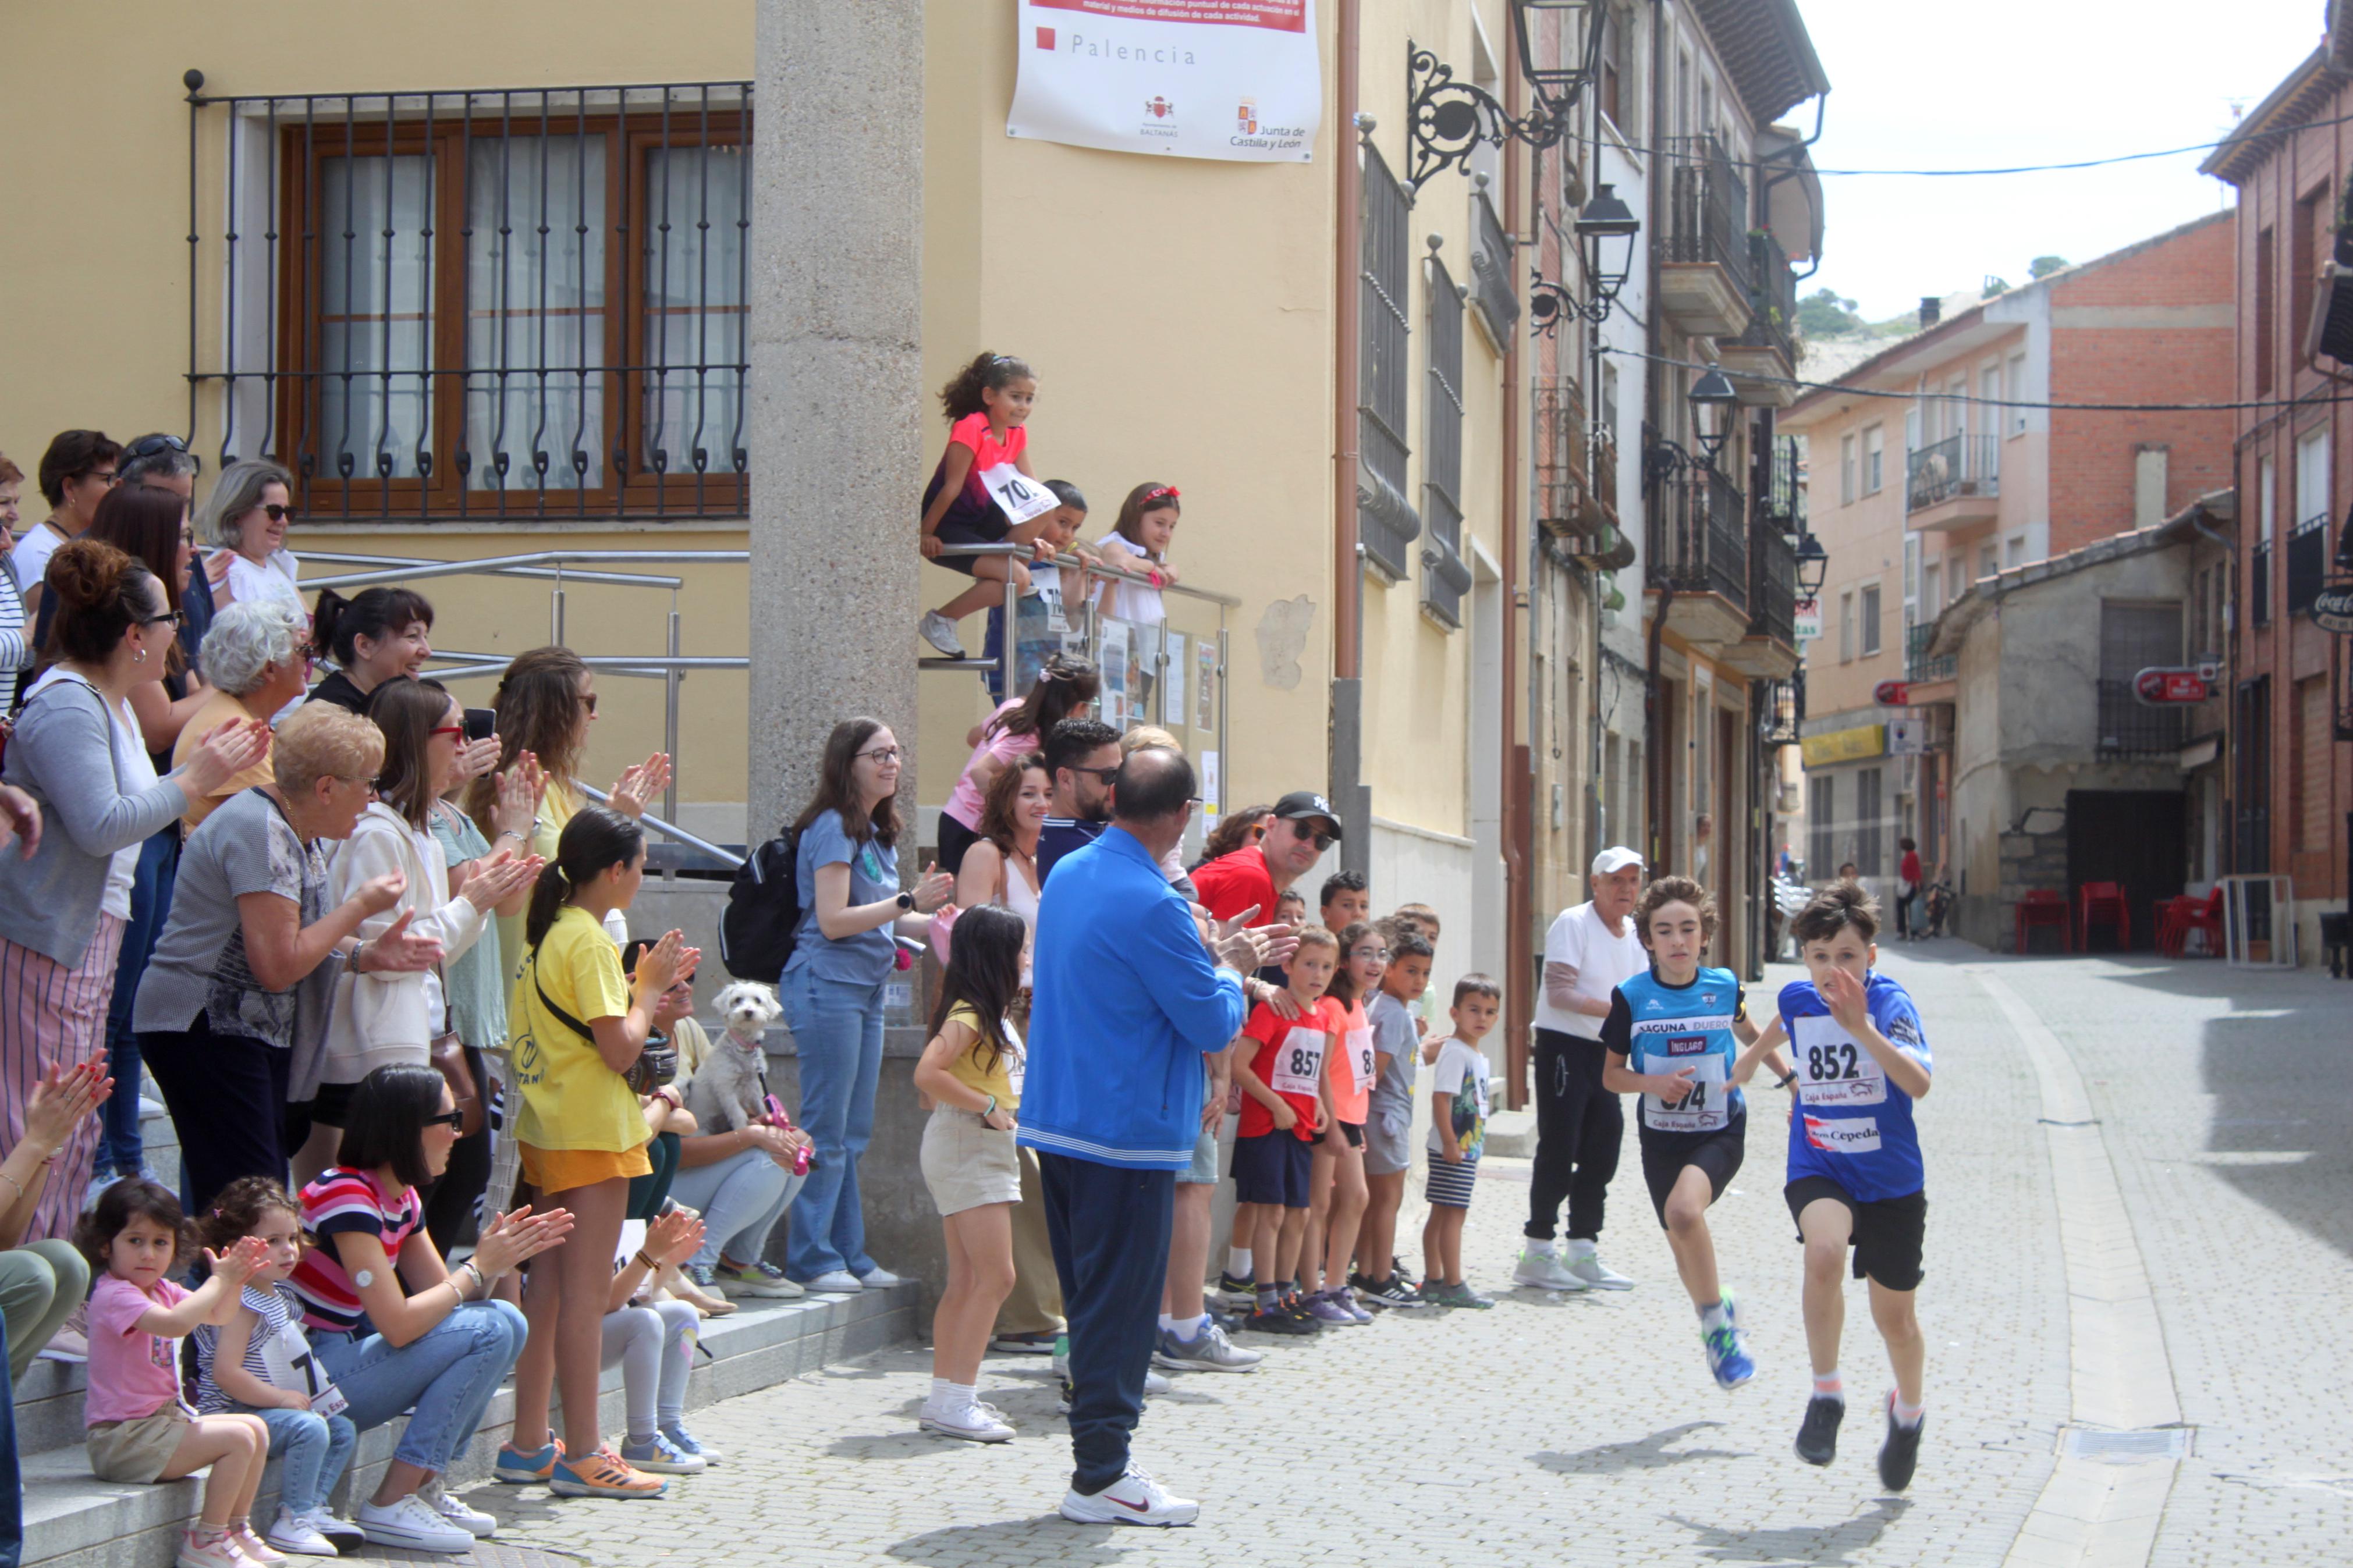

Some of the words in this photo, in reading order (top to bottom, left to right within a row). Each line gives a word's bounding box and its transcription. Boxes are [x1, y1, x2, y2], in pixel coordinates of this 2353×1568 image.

[1071, 34, 1195, 65] Palencia
[1260, 126, 1290, 136] Junta
[1292, 127, 1305, 137] de
[1230, 136, 1268, 147] Castilla
[1268, 140, 1276, 151] y
[1278, 139, 1301, 148] León
[1693, 1021, 1729, 1030] DUERO
[1291, 1048, 1321, 1079] 857
[1808, 1043, 1860, 1081] 852
[1805, 1093, 1820, 1103] Caja
[1822, 1091, 1847, 1102] España
[1830, 1128, 1879, 1142] Cepeda
